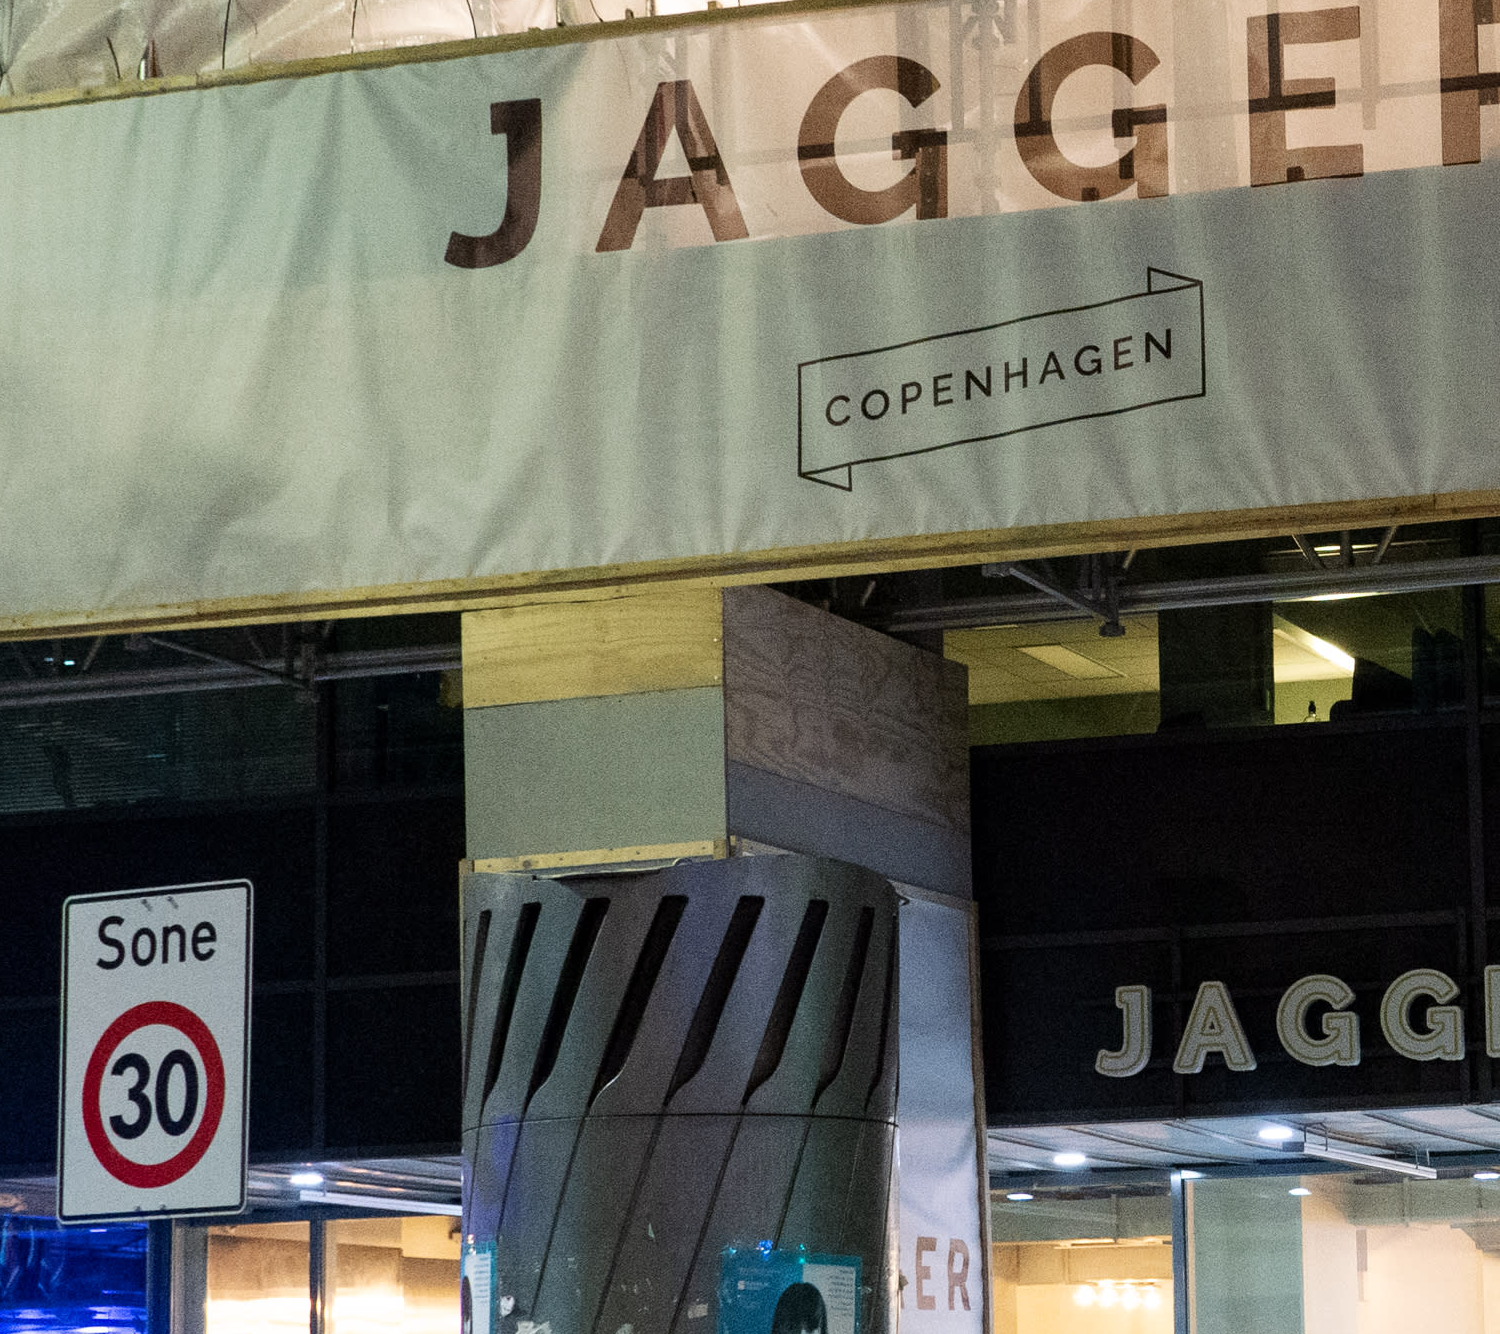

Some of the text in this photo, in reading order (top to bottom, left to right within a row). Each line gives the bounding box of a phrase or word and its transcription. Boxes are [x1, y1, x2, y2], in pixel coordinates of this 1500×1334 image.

[824, 328, 1176, 428] COPENHAGEN
[95, 915, 218, 972] Sone
[108, 1049, 198, 1140] 30
